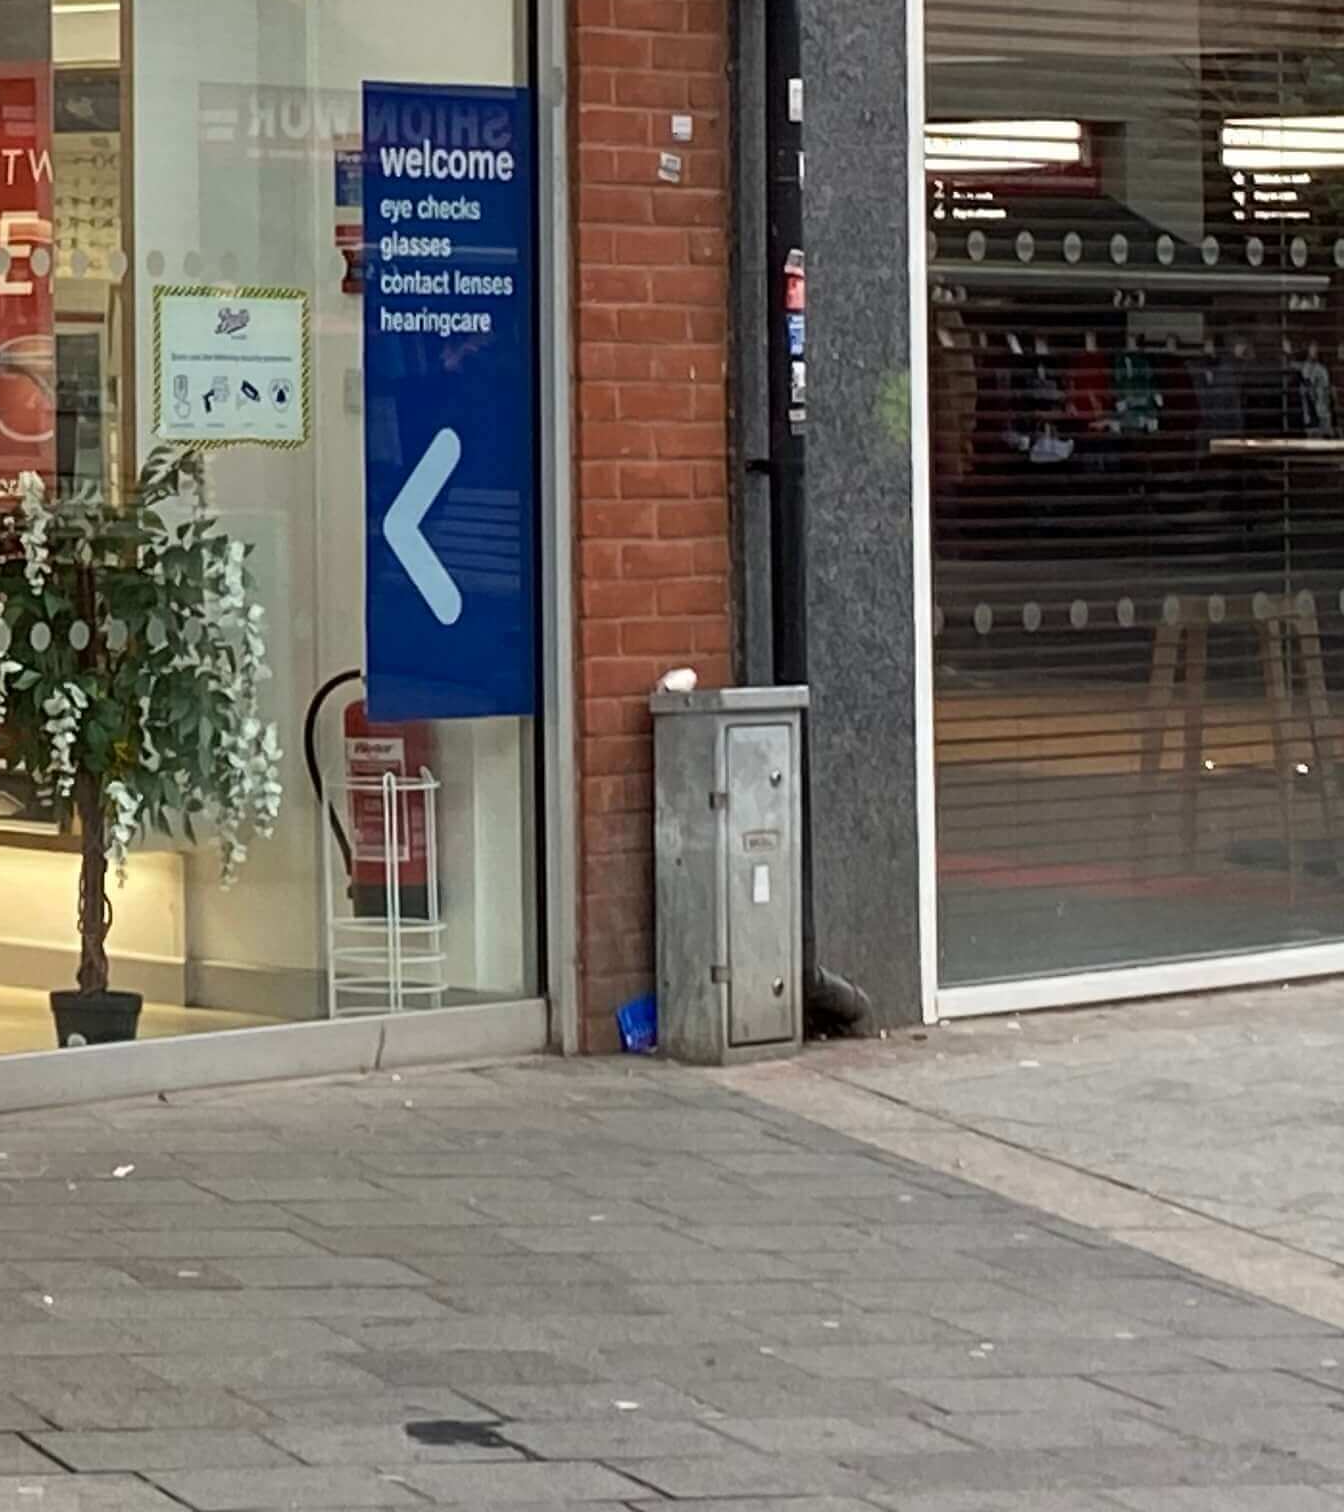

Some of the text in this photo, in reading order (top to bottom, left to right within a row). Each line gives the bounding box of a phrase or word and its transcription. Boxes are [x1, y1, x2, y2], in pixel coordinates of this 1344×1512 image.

[380, 139, 515, 181] welcome
[380, 194, 481, 224] eye checks
[380, 235, 451, 261] glasses
[380, 269, 514, 296] contact lenses
[380, 305, 492, 338] hearingcare
